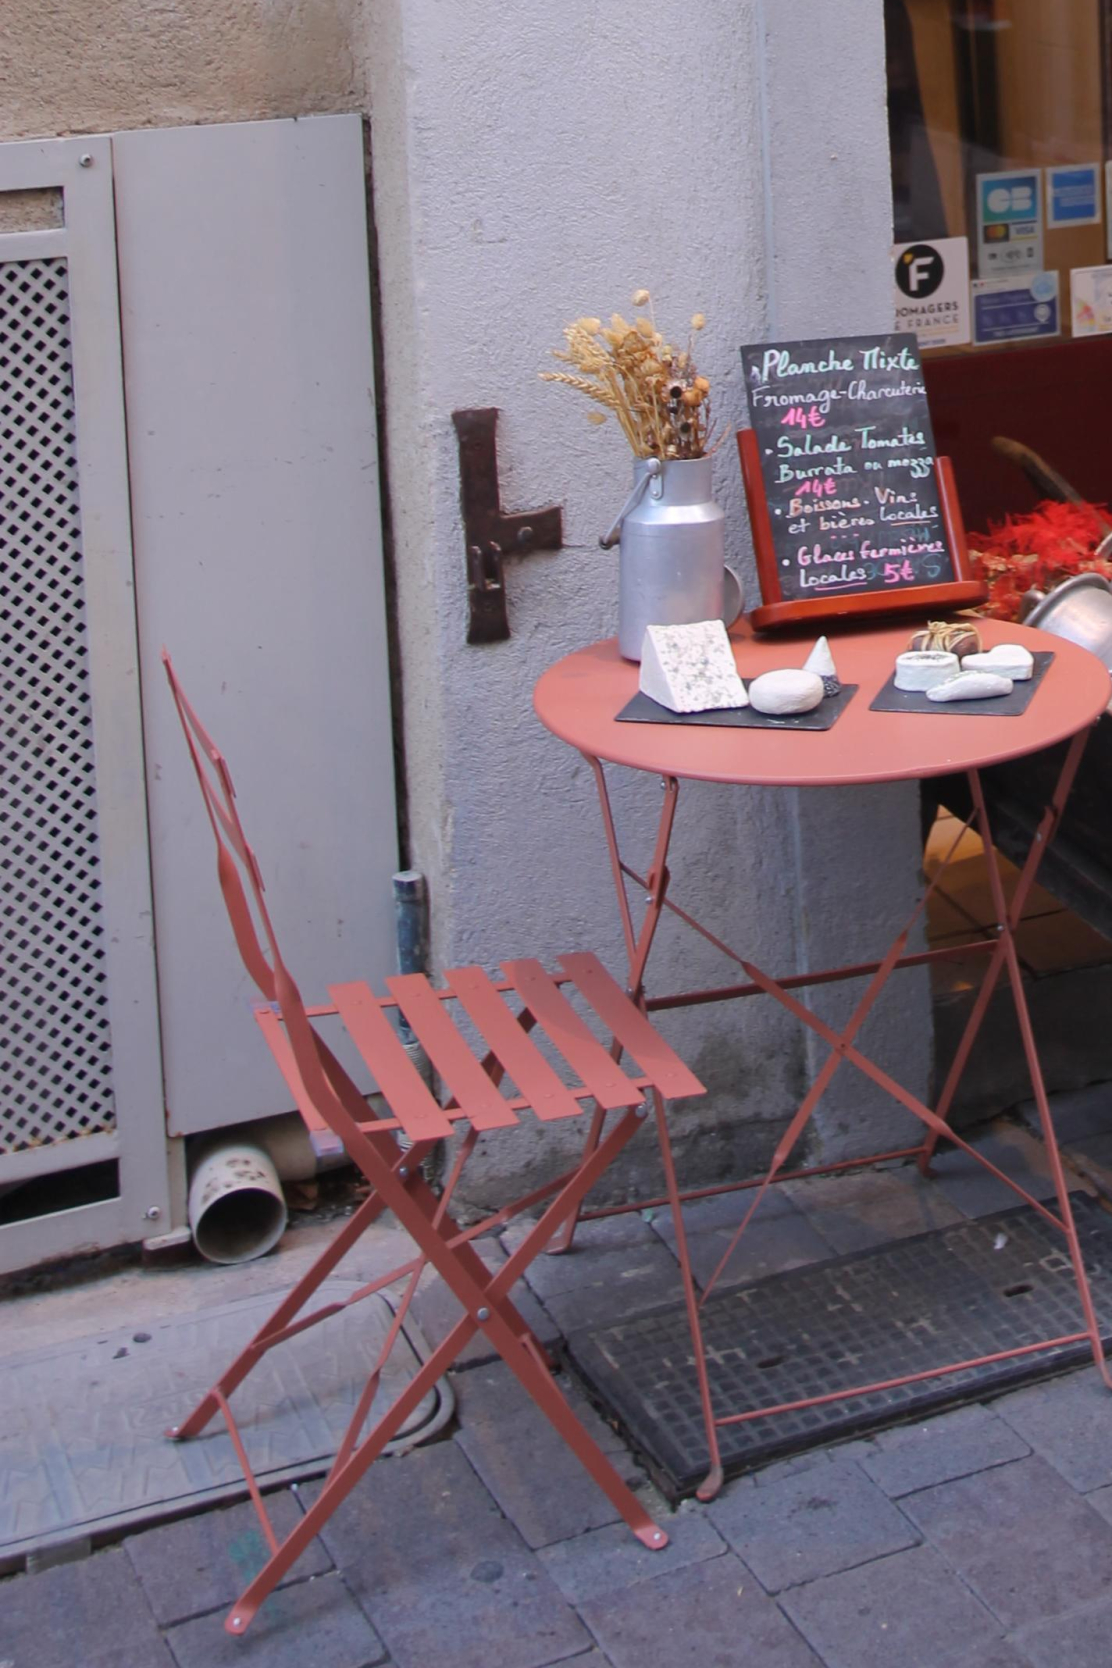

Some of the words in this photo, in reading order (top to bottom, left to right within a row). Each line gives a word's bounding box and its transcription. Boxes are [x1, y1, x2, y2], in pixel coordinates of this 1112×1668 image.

[907, 313, 959, 328] FRANCE
[761, 349, 855, 383] Planche
[859, 346, 921, 372] Mixte
[752, 380, 928, 414] Fromage-Charcuterie
[781, 405, 826, 429] 14€
[777, 435, 852, 458] Salade
[855, 425, 926, 450] Tomates
[777, 457, 858, 483] Burrata
[864, 461, 883, 471] ou
[887, 456, 935, 479] mozza
[795, 477, 838, 497] 14€
[874, 486, 918, 505] Vins
[788, 520, 811, 534] et
[819, 511, 875, 531] bières
[797, 544, 855, 567] Glaces
[883, 559, 915, 583] 5€
